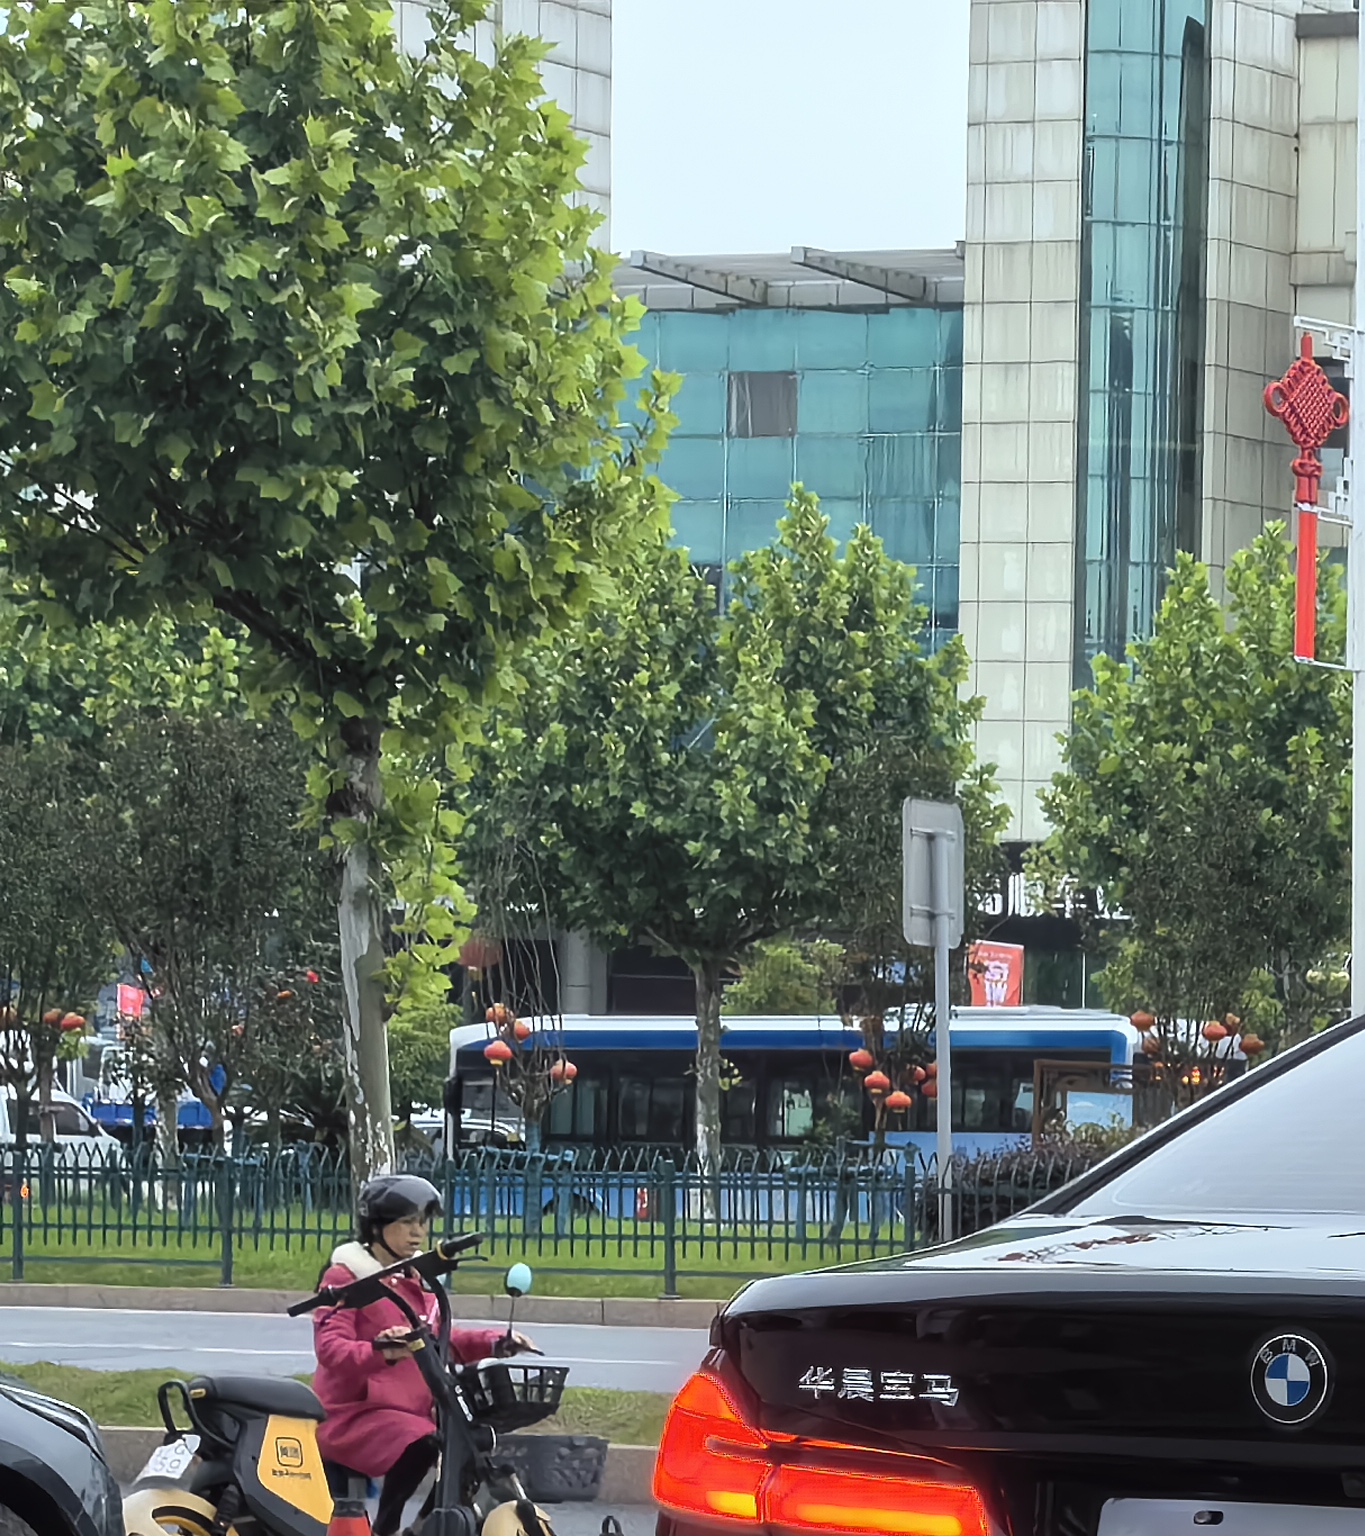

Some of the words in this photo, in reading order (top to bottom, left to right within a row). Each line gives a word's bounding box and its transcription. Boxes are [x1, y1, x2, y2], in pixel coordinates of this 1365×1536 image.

[1260, 1338, 1320, 1367] BMW
[799, 1365, 960, 1407] 华晨宝马
